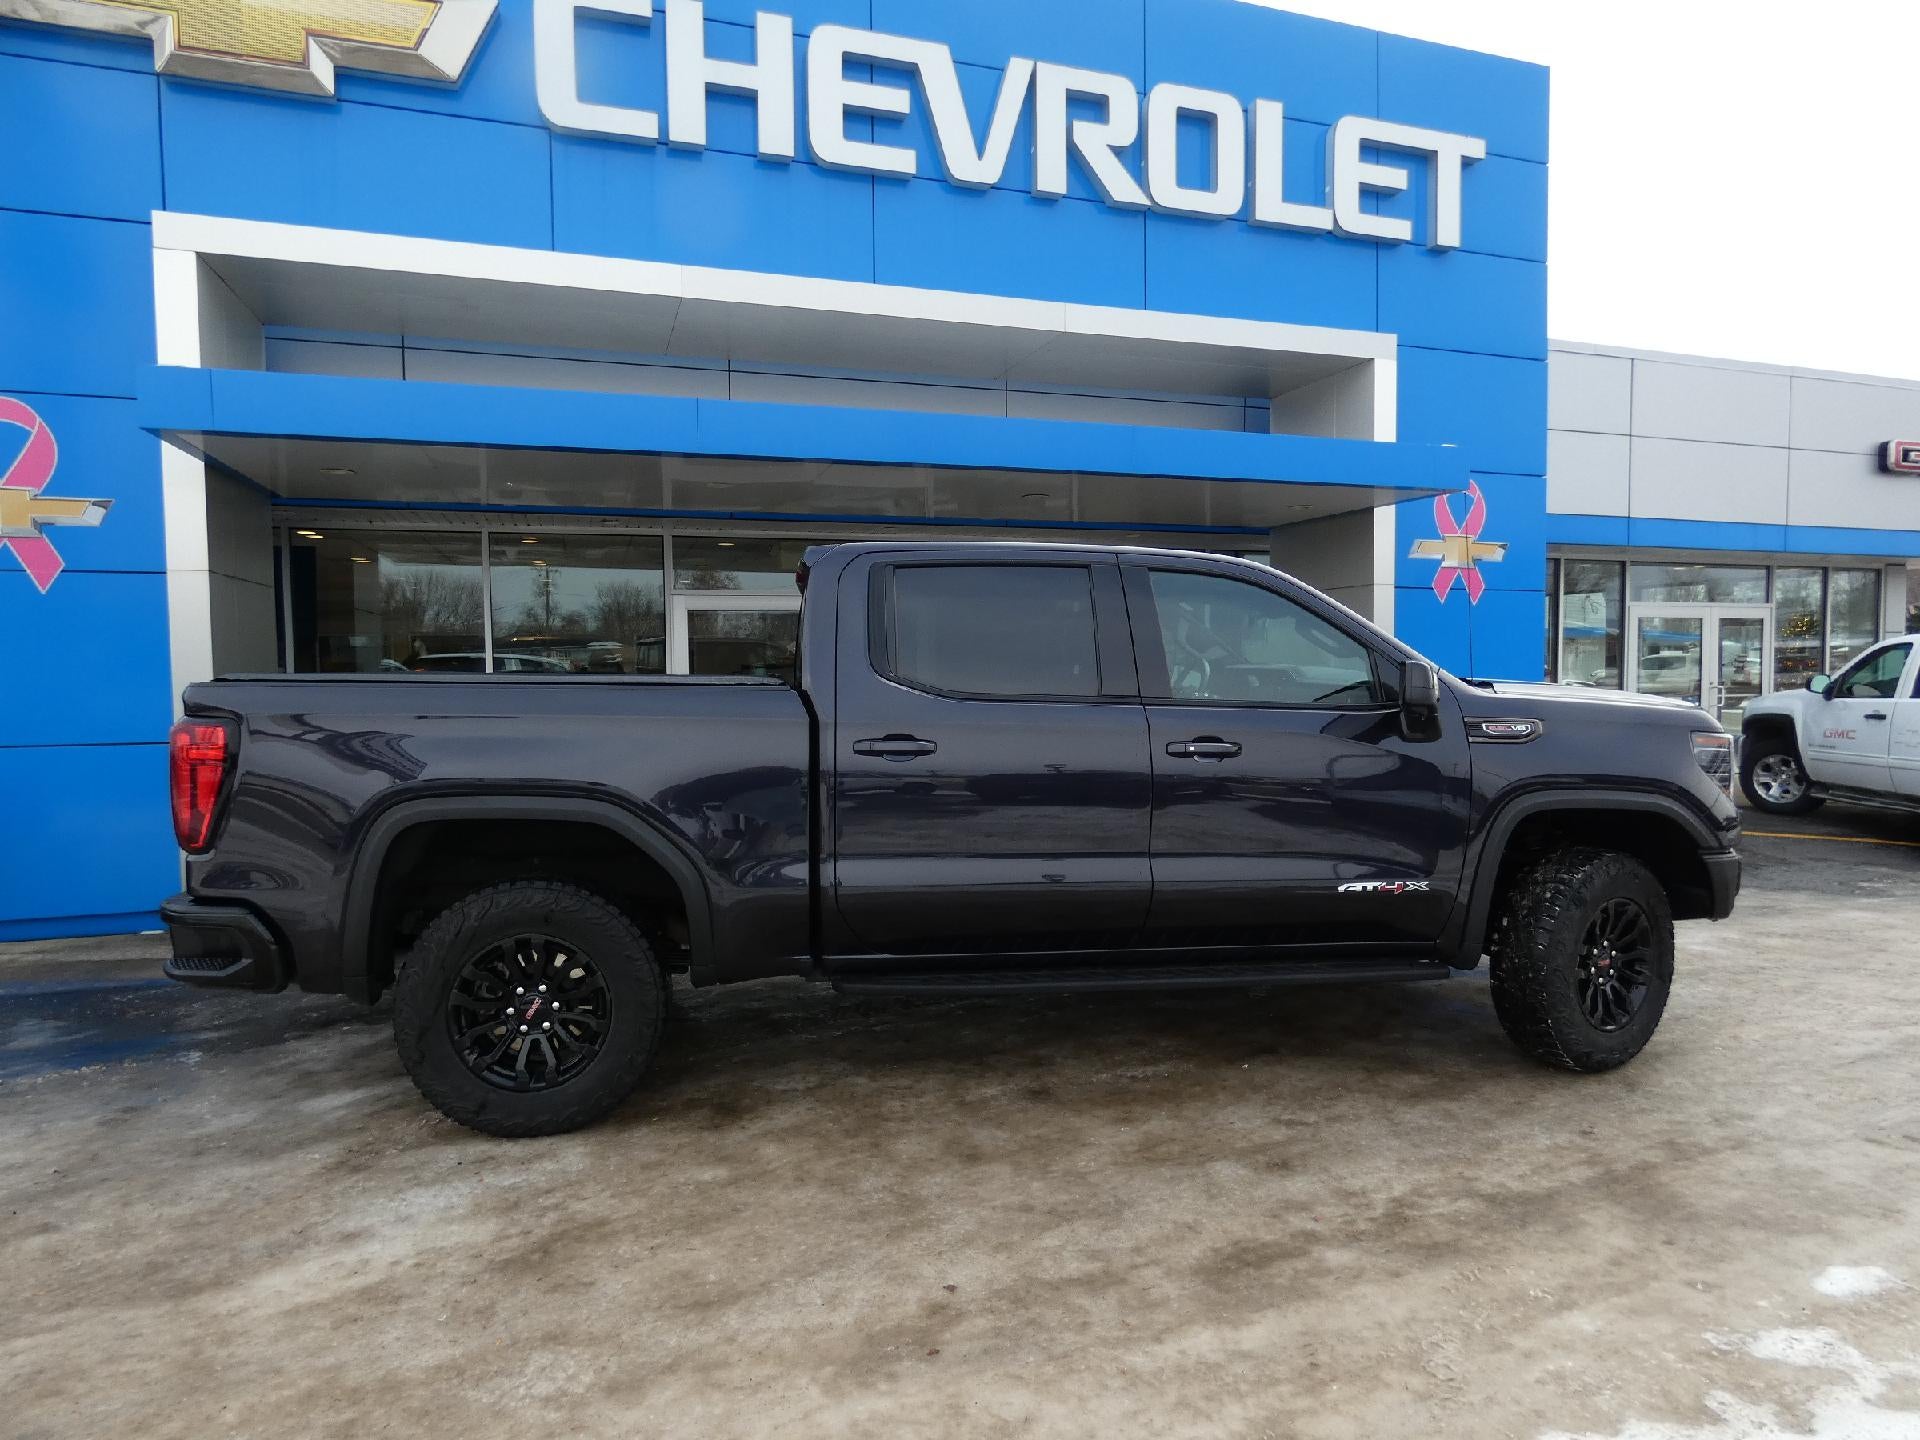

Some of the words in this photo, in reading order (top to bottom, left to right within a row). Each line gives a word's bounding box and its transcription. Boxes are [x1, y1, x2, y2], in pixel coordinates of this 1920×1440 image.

[534, 0, 1486, 249] CHEVROLET
[1823, 729, 1857, 740] GMC
[1337, 881, 1430, 895] AT4X
